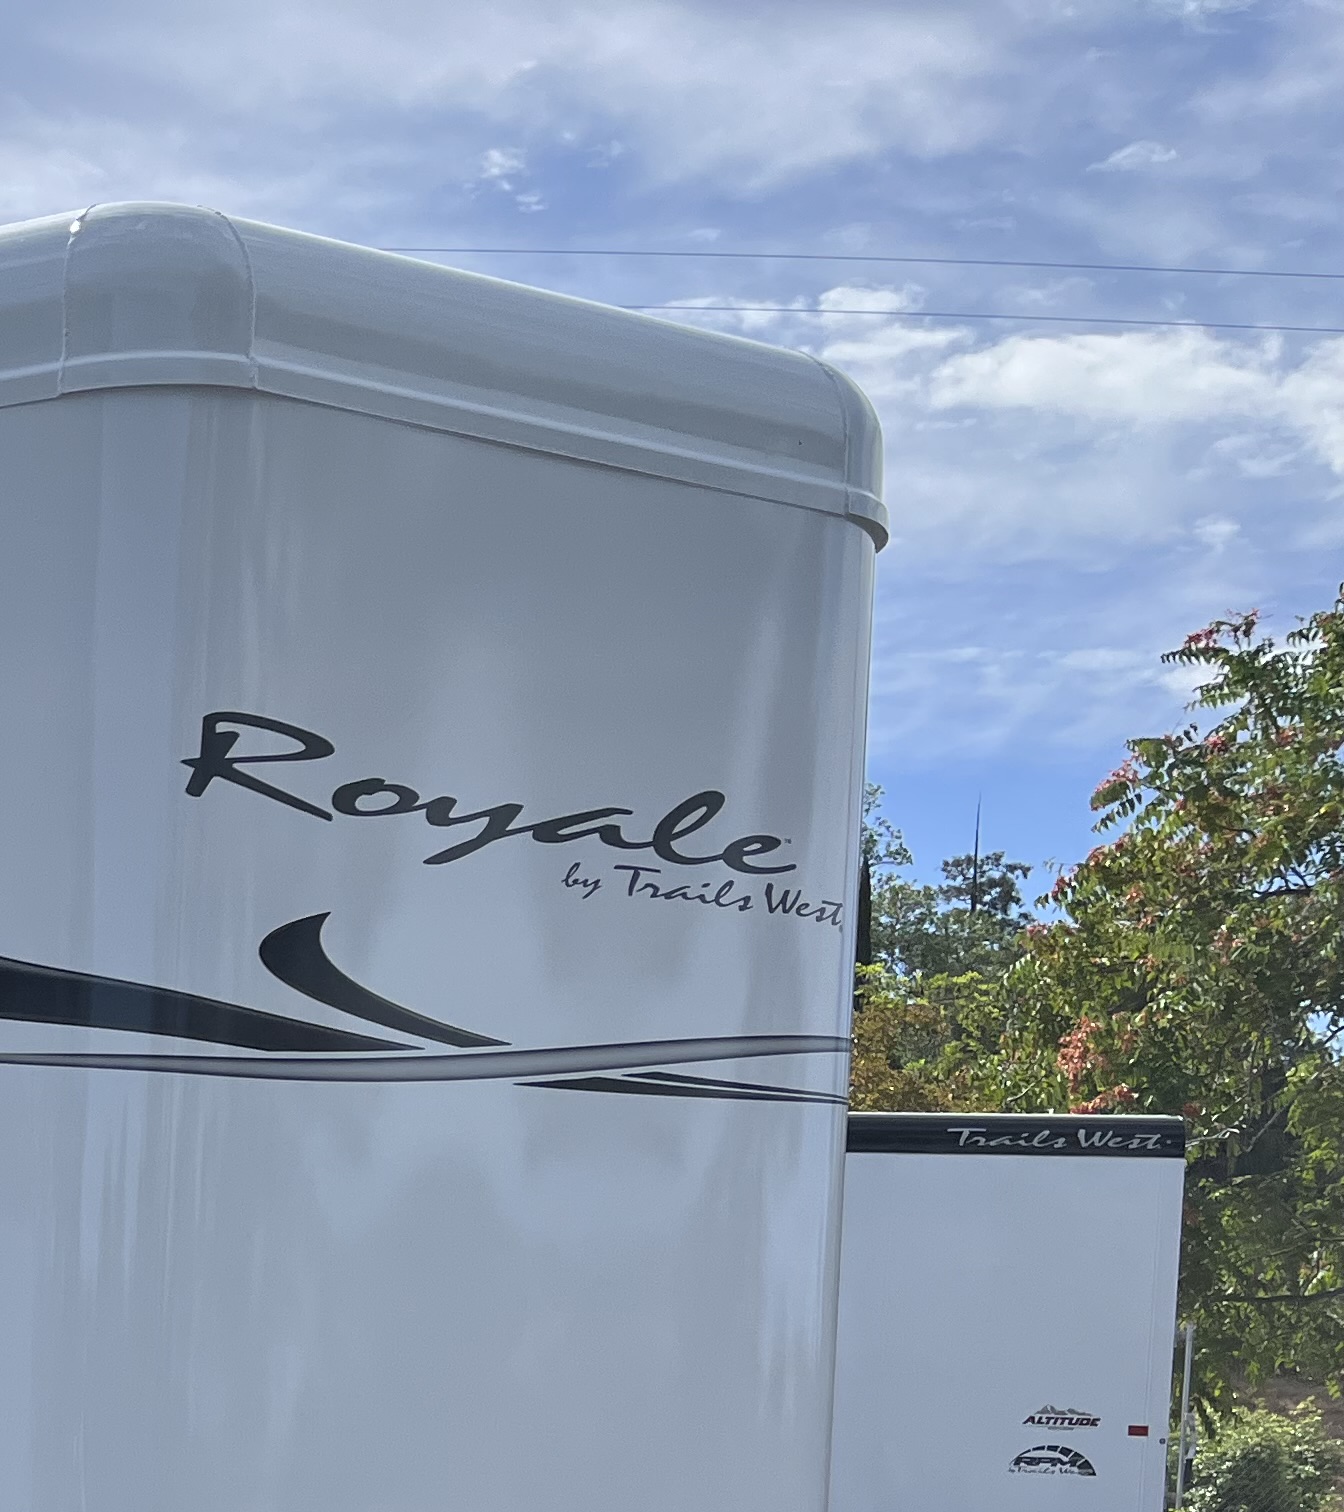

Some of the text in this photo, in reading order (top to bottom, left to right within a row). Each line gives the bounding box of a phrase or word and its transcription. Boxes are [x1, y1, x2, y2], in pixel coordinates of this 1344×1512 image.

[179, 711, 797, 874] Royale
[561, 862, 843, 926] by Trails West
[946, 1127, 1162, 1150] Trails West
[1021, 1415, 1102, 1428] ALTITUDE
